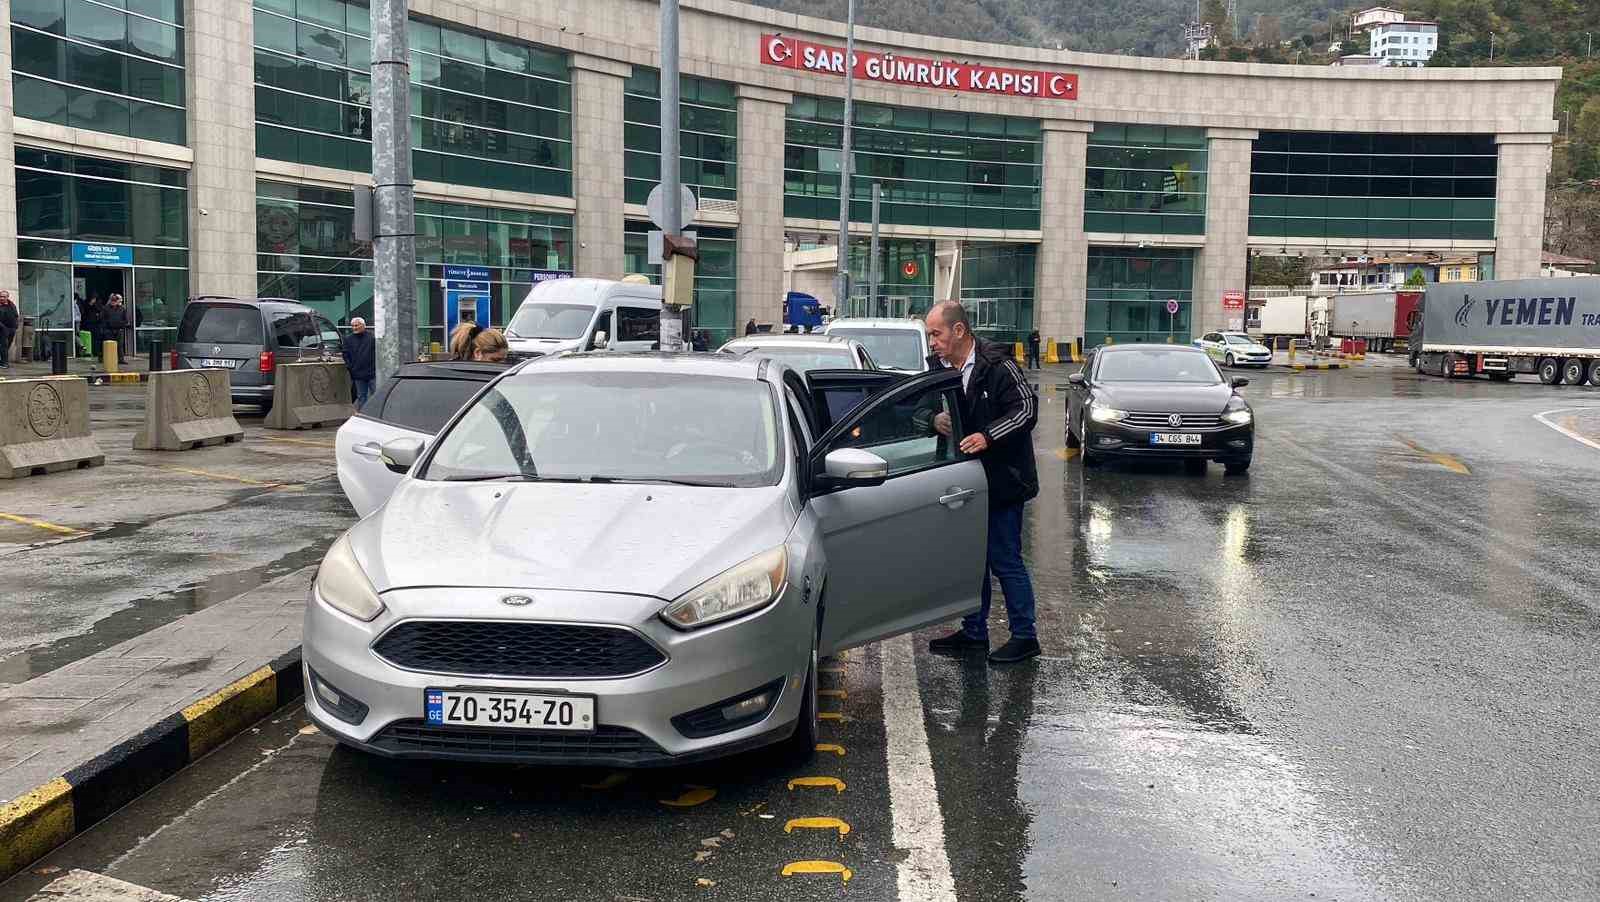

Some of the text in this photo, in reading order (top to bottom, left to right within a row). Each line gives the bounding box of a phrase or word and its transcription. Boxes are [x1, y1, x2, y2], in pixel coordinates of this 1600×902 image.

[865, 56, 960, 87] GÜMRÜK
[970, 70, 1039, 94] KAPISI
[1485, 297, 1577, 326] YEMEN
[428, 710, 442, 721] GE
[447, 696, 573, 726] ZO-354-ZO
